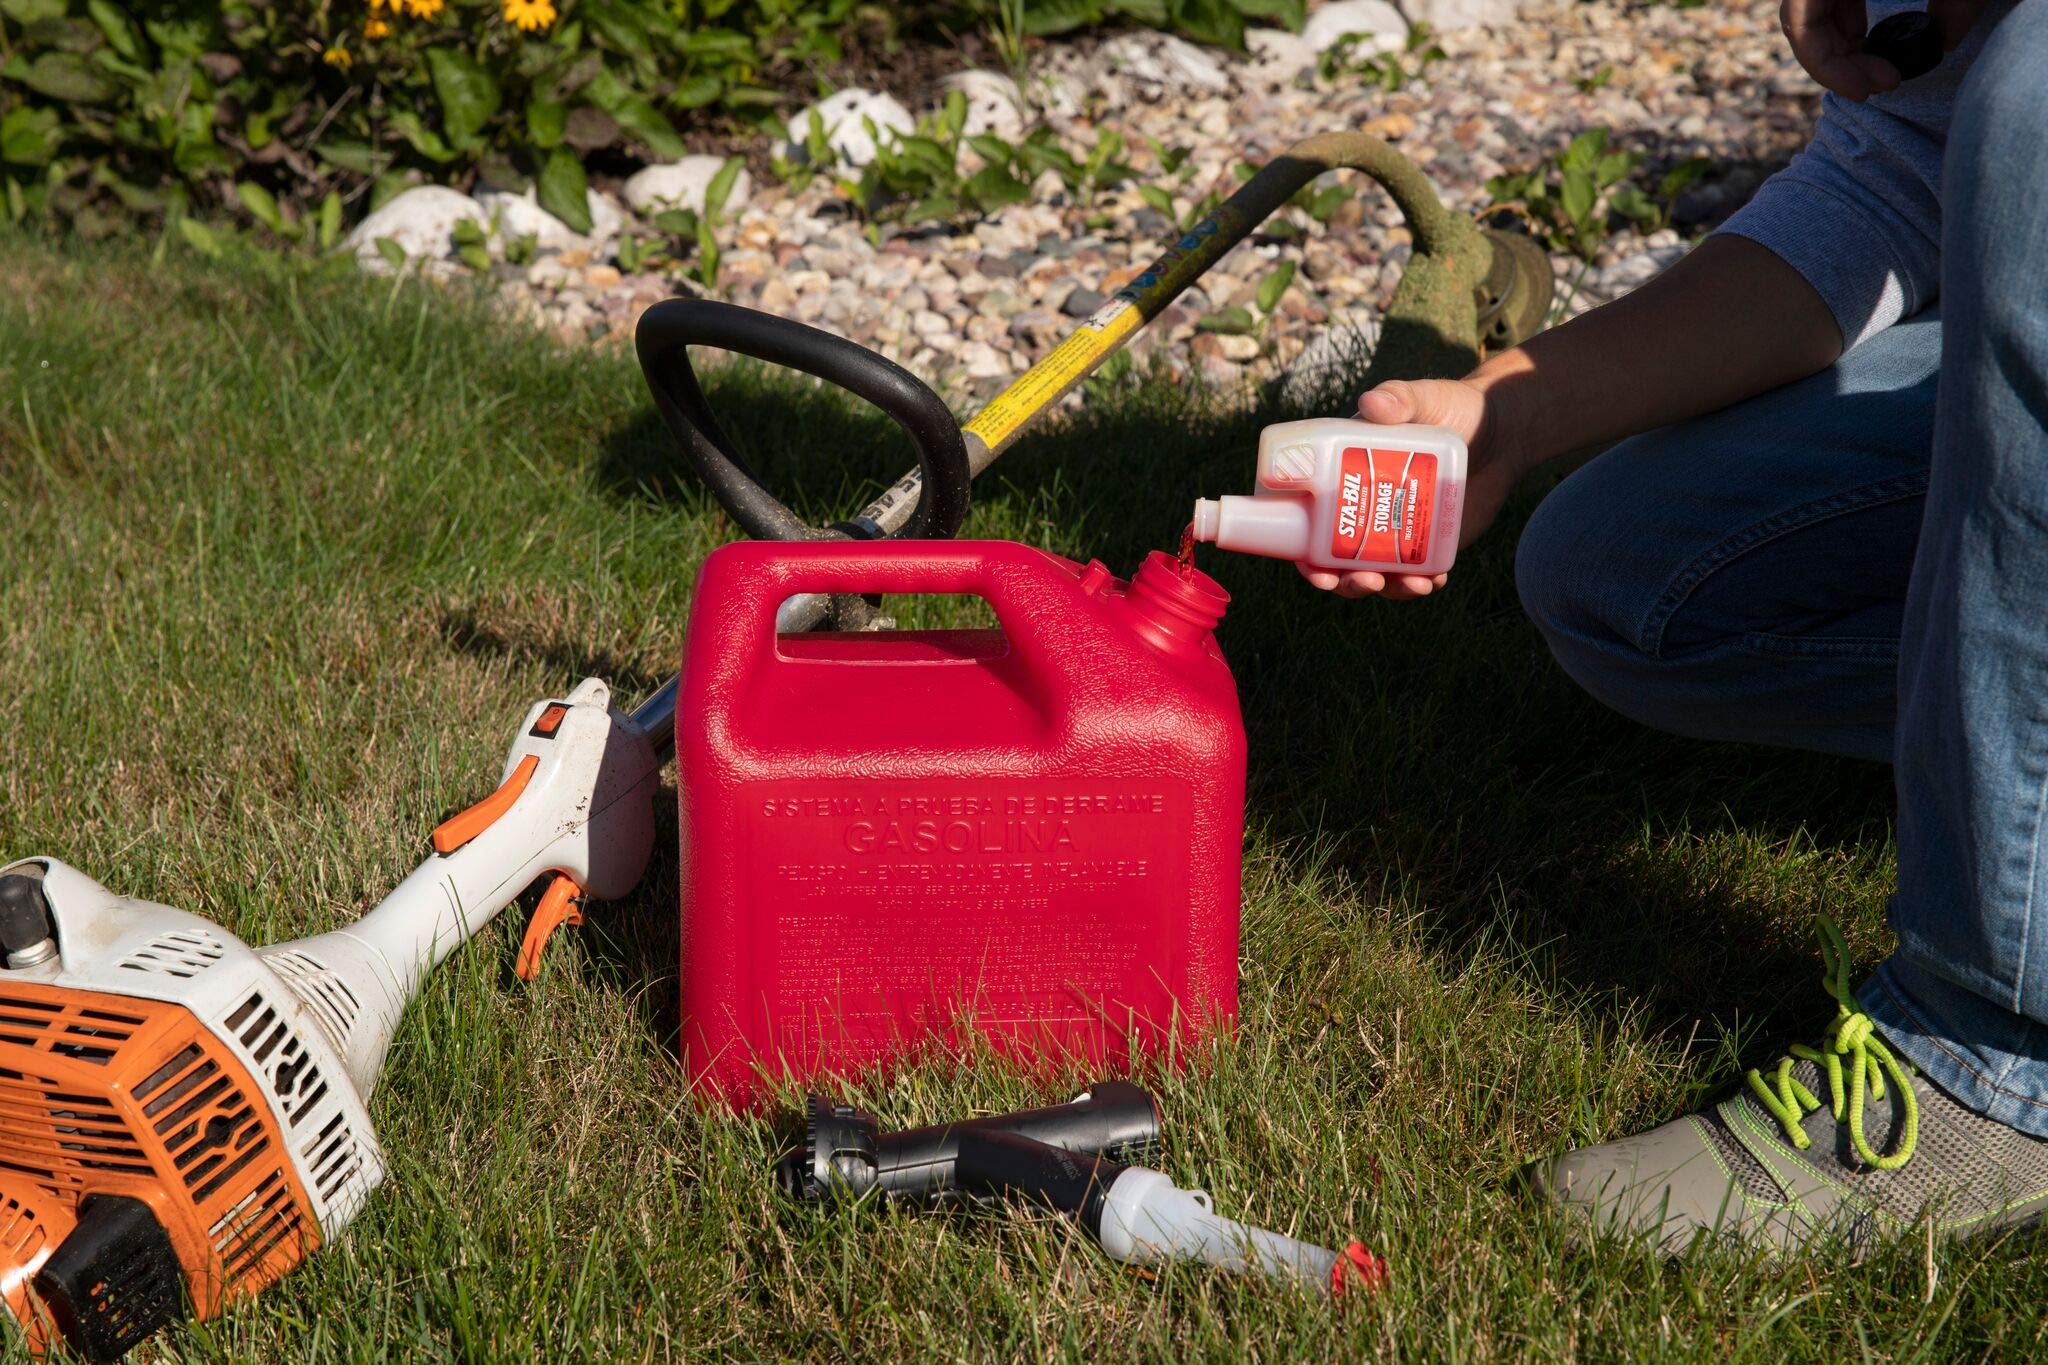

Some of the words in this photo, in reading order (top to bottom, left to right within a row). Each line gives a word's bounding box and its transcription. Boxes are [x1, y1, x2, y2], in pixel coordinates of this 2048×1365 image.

[1338, 473, 1361, 538] STA-BIL
[1374, 482, 1393, 533] STORAGE
[1408, 479, 1418, 504] GALLONS
[761, 798, 867, 818] SISTEMA
[873, 797, 890, 816] A
[898, 796, 994, 816] PRUEBA
[1005, 796, 1036, 815] DE
[1044, 795, 1165, 815] DERRAME
[844, 820, 1080, 855] GASOLINA
